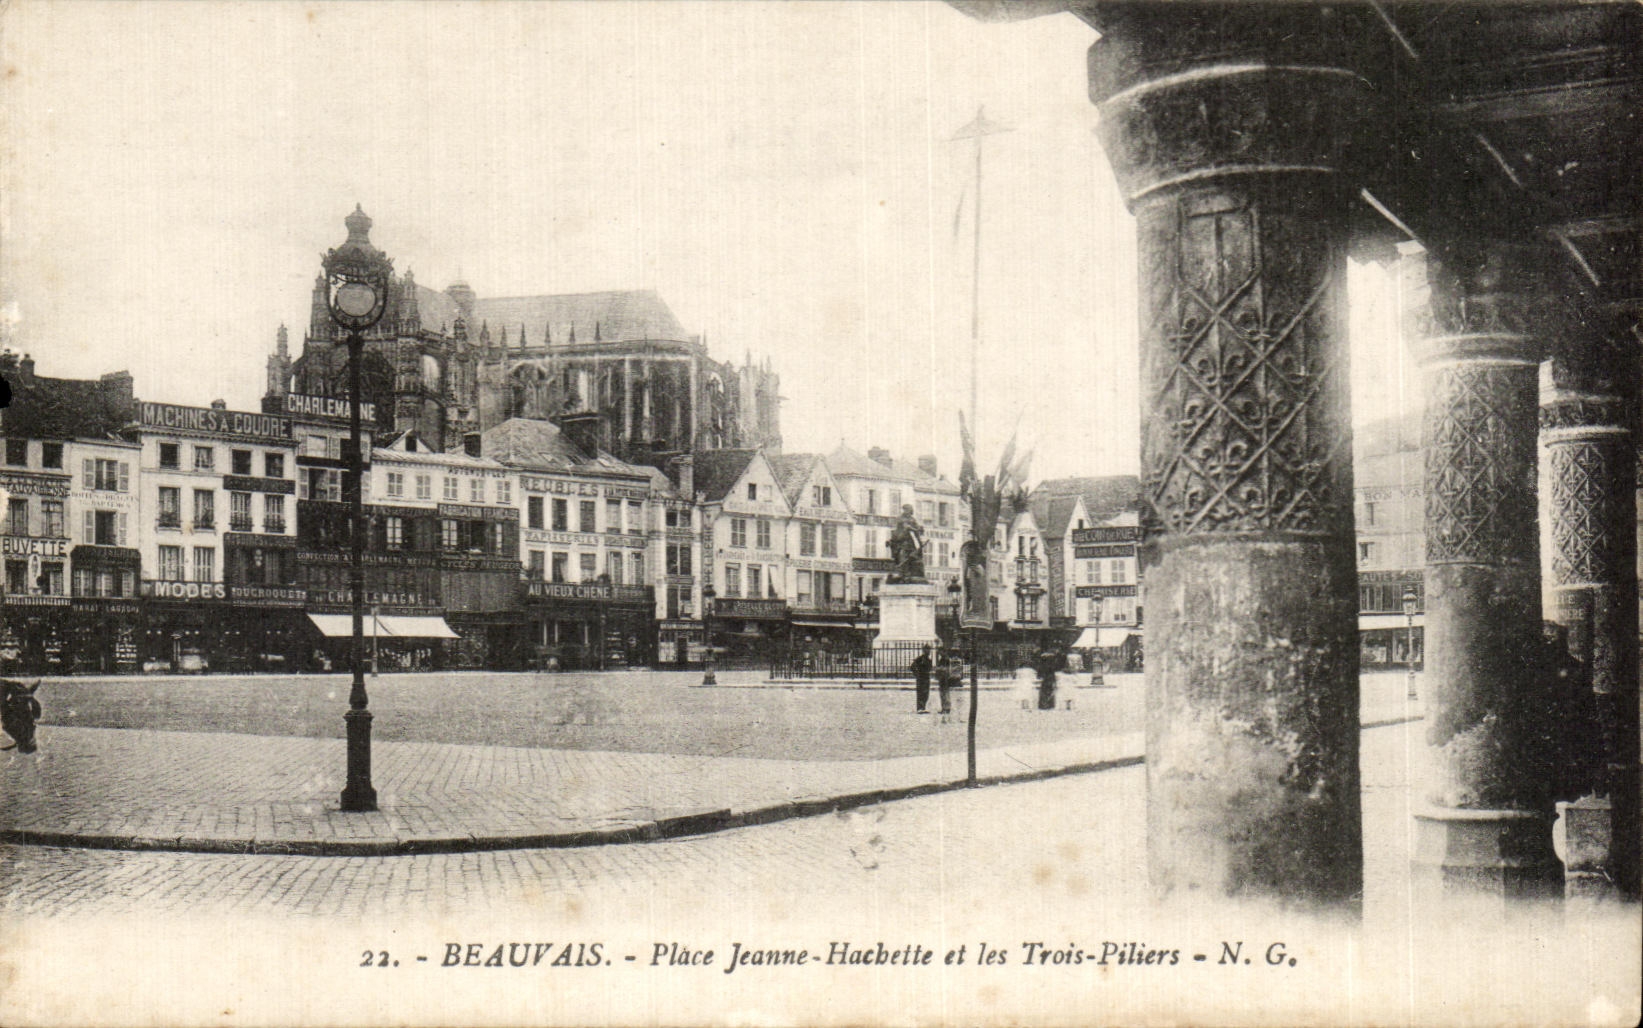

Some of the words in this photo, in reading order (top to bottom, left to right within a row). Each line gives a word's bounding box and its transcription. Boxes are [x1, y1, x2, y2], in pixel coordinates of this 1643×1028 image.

[288, 393, 377, 422] CHARLEMANE
[143, 405, 217, 431] MACHINES
[234, 413, 289, 438] COUDRE
[520, 476, 598, 497] MEUBLES
[2, 538, 68, 558] BUVETTE
[155, 581, 226, 599] MODES
[327, 590, 425, 605] CHALEMAGNE
[527, 583, 542, 597] AU
[544, 584, 574, 598] VIEUX
